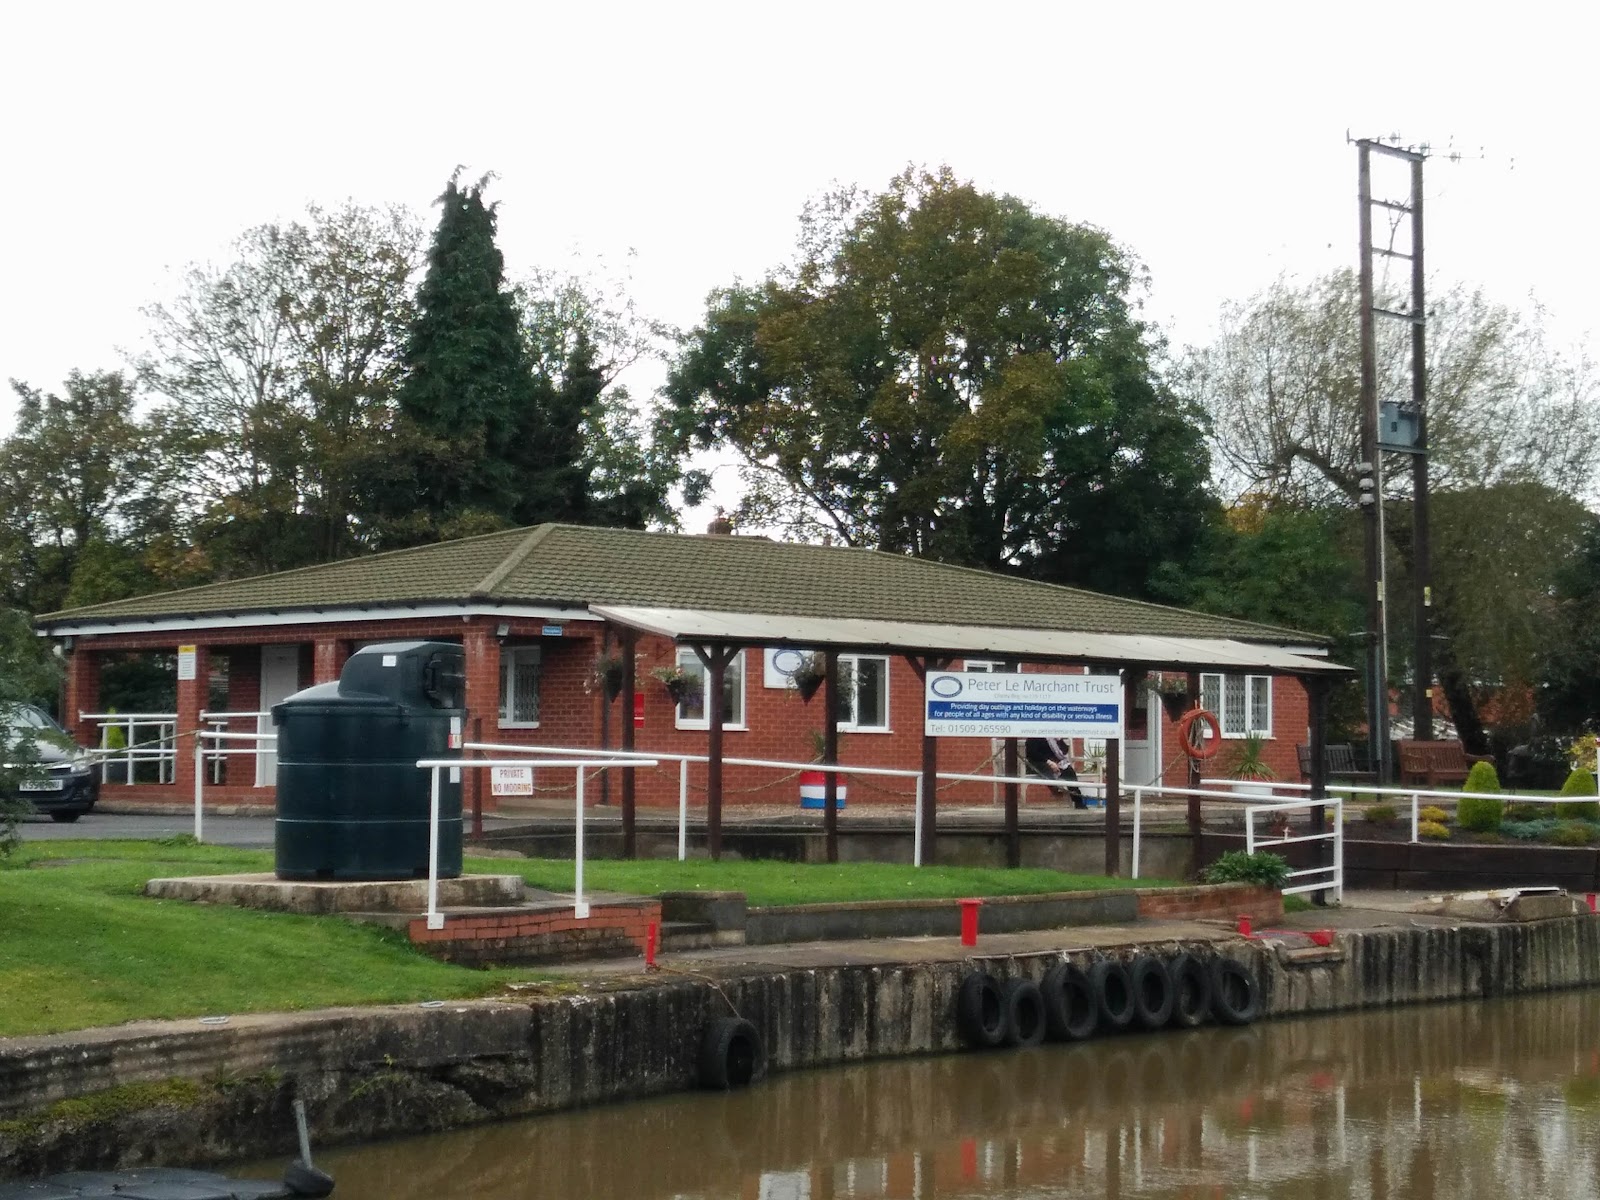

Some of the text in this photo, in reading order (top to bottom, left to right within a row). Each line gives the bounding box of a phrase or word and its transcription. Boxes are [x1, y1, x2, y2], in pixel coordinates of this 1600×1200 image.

[968, 678, 1114, 694] Peter Le Marchant Trust
[950, 703, 978, 711] Providing
[990, 704, 1011, 712] outings
[1009, 712, 1020, 720] any
[1041, 712, 1066, 720] disability
[931, 724, 1011, 734] Tel: 01509 265590
[499, 769, 524, 779] PRIVATE
[493, 783, 532, 793] NO MOORING
